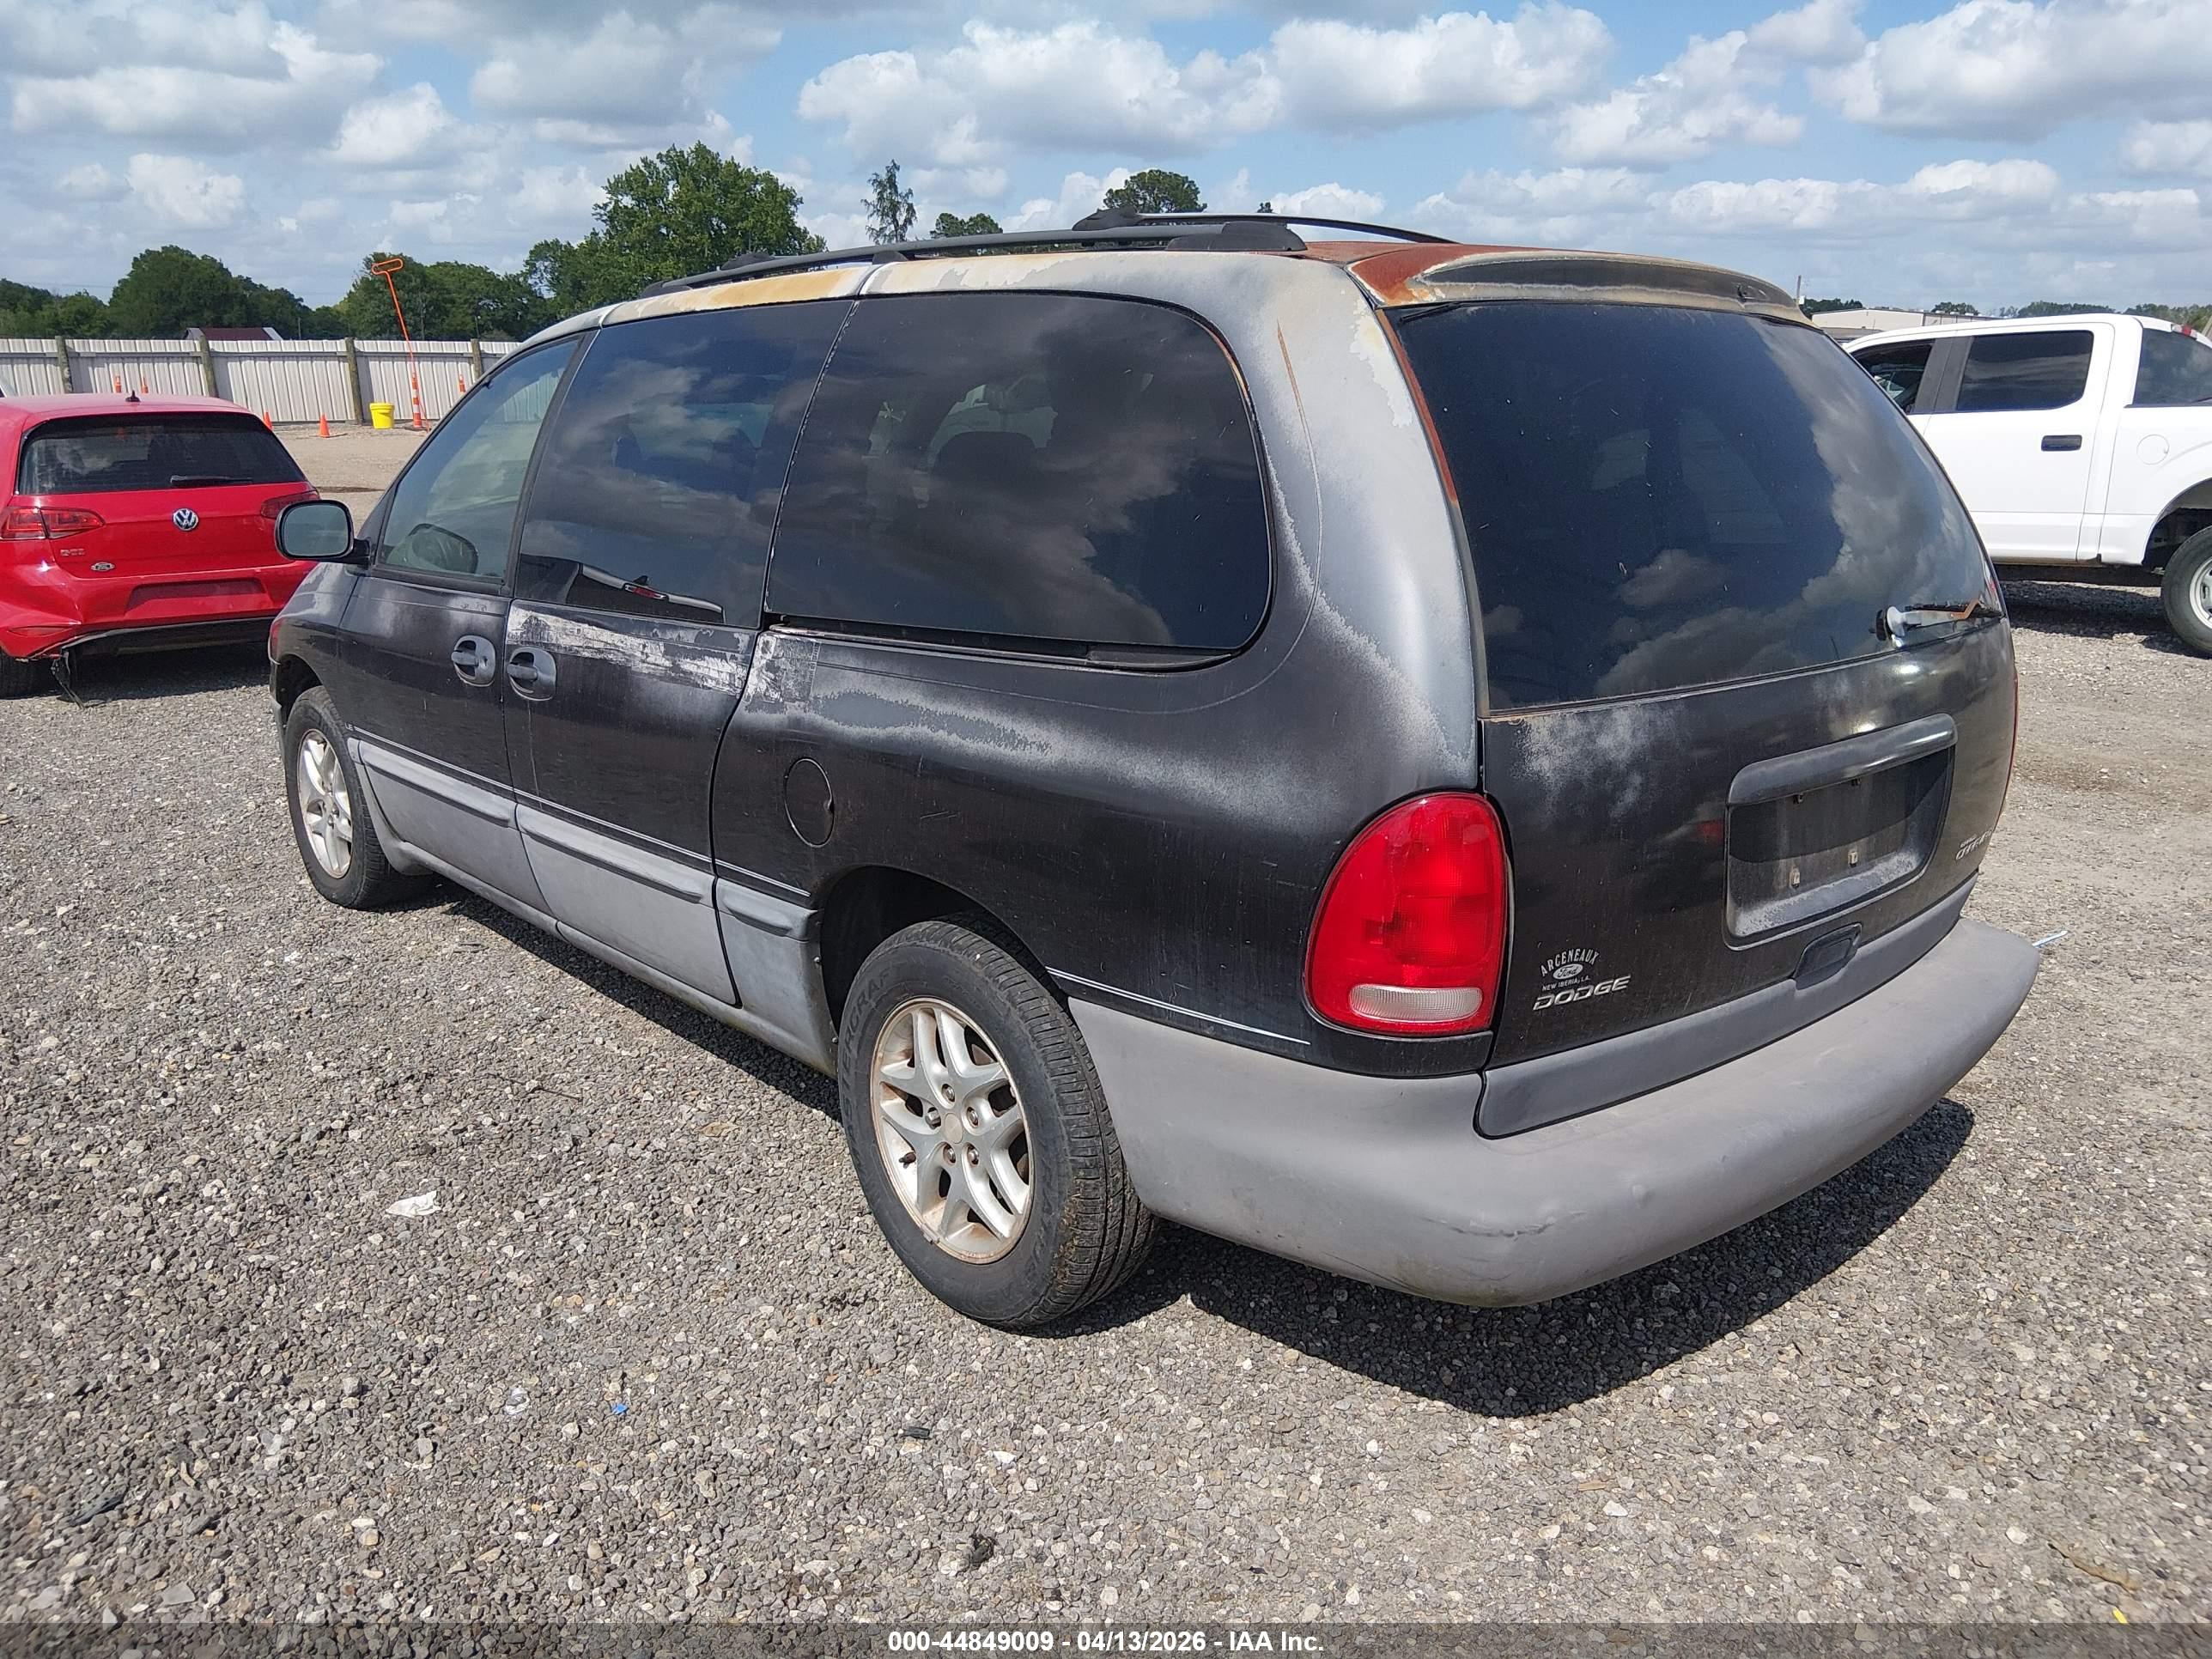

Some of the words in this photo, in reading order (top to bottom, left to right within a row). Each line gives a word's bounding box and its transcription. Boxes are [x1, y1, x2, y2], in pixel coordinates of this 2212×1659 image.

[1540, 948, 1600, 977] ARCENEAUX
[1556, 964, 1581, 979] Ford
[1533, 975, 1632, 1011] DODGE
[1541, 983, 1557, 992] NEW
